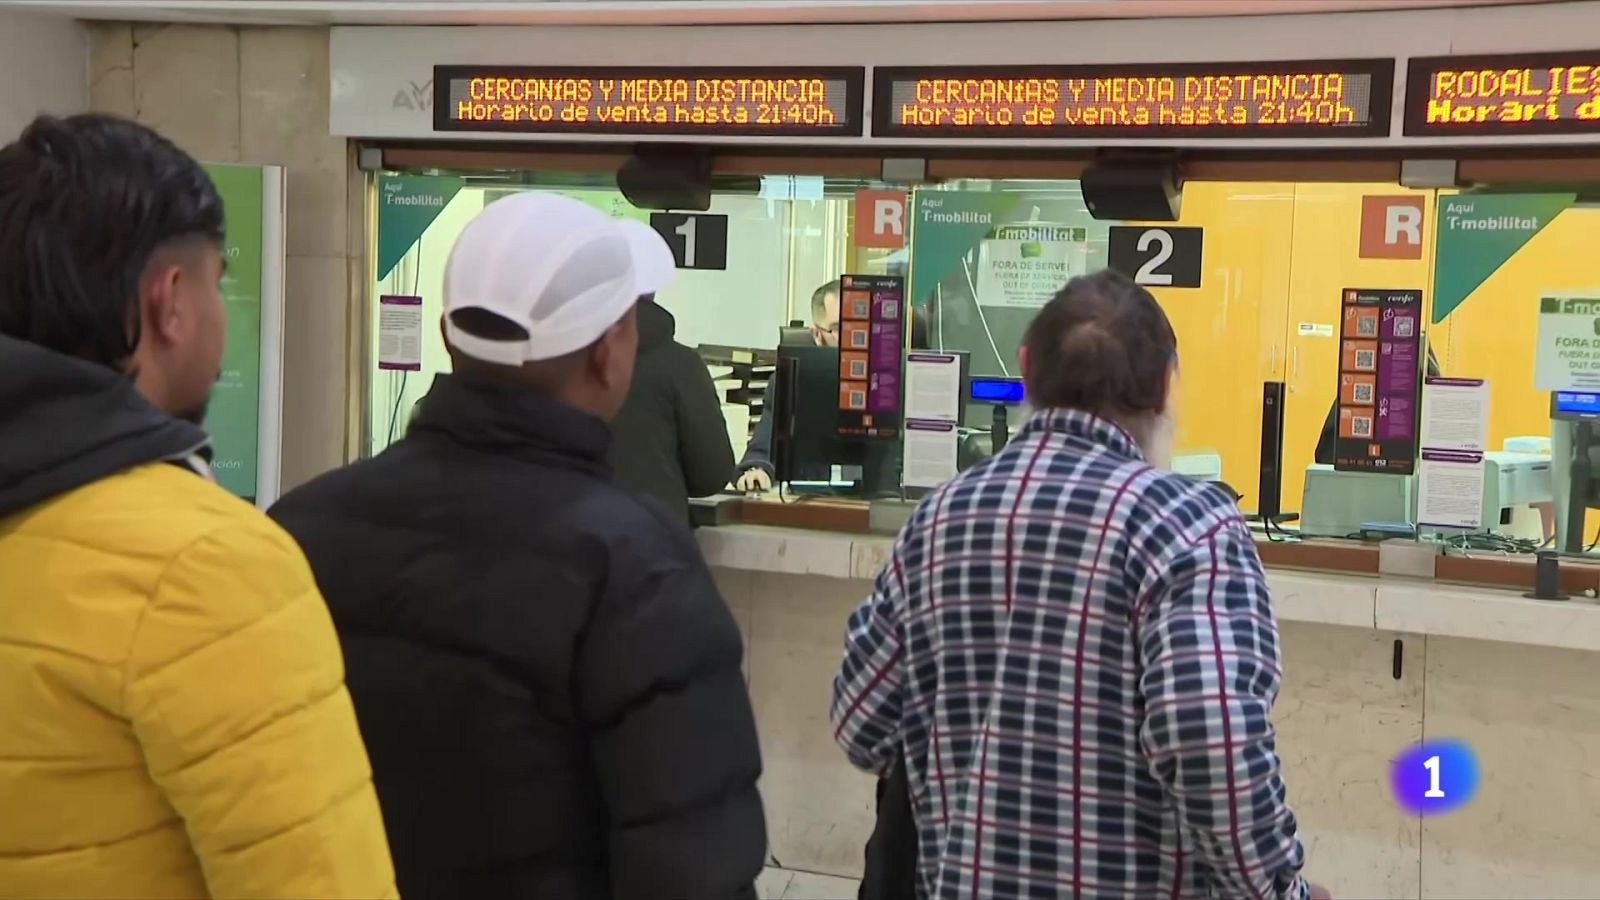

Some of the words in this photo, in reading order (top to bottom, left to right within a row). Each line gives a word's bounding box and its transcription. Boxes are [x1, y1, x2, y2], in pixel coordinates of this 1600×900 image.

[600, 79, 614, 101] Y
[621, 79, 688, 101] MEDIA
[695, 79, 824, 102] DISTANCIA
[1068, 79, 1085, 102] Y
[1094, 77, 1175, 102] MEDIA
[1184, 74, 1343, 101] DISTANCIA
[458, 101, 553, 121] Horario
[560, 102, 589, 122] de
[596, 103, 667, 123] venta
[675, 103, 748, 124] hasta
[756, 104, 834, 124] 21:40h
[902, 104, 1013, 125] Horario
[1022, 104, 1056, 125] de
[1065, 103, 1149, 125] venta
[1159, 102, 1248, 125] hasta
[1257, 100, 1354, 125] 21:40h
[1426, 96, 1561, 123] Horari
[921, 198, 944, 209] Aquí
[1446, 202, 1475, 215] Aquí
[873, 199, 903, 236] R
[1384, 205, 1422, 245] R
[675, 216, 696, 267] 1
[1134, 228, 1174, 286] 2
[1555, 337, 1590, 348] FORA
